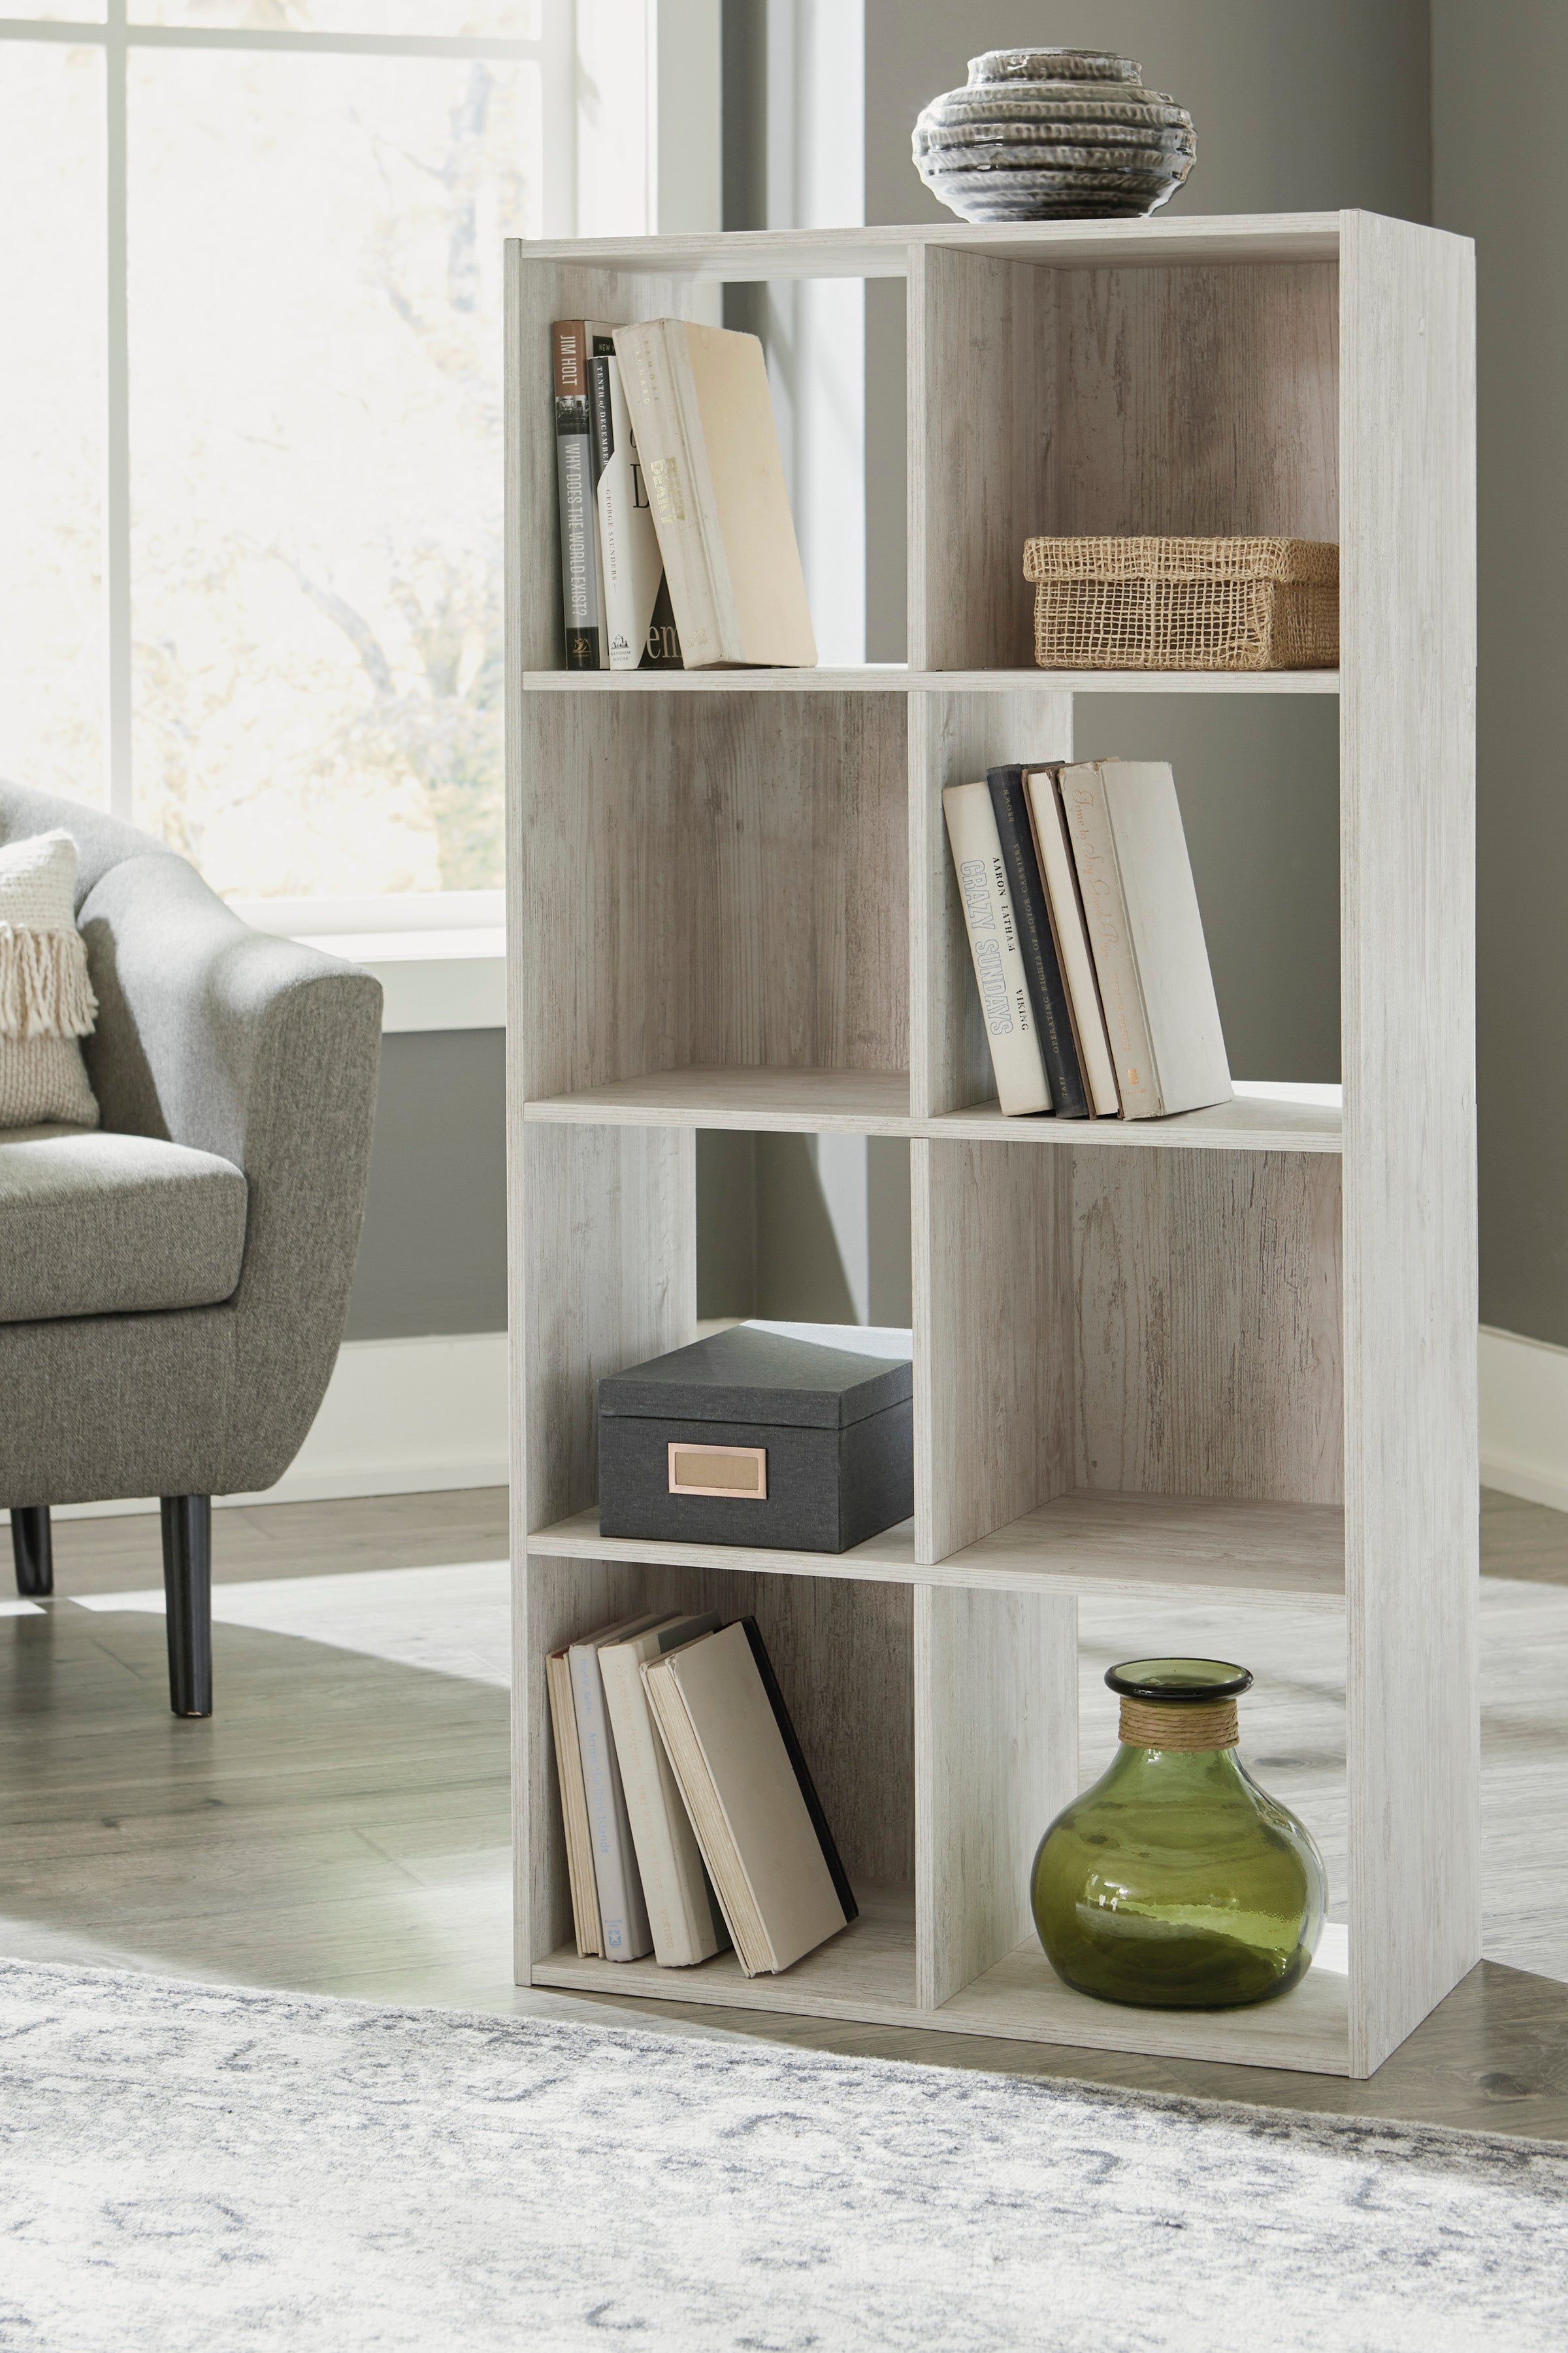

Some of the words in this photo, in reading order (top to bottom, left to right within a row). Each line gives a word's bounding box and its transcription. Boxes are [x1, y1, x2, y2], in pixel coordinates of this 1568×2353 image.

[560, 335, 576, 355] JIM
[561, 358, 578, 386] HOLT
[564, 443, 581, 470] WHY
[600, 412, 610, 466] DECEMBER
[566, 474, 582, 504] DOES
[568, 507, 583, 529] THE
[605, 489, 613, 527] GEORGE
[568, 532, 585, 574] WORLD
[608, 531, 617, 581] SAUNDERS
[570, 576, 587, 616] EXIST?
[1003, 789, 1015, 823] BROWN
[1072, 789, 1094, 827] Time
[1080, 830, 1089, 840] to
[1013, 843, 1028, 893] CARRIERS
[960, 859, 996, 930] CRAZY
[1024, 899, 1036, 934] MOTOR
[992, 857, 1006, 897] AARON
[1001, 905, 1016, 951] LATHAM
[1015, 989, 1029, 1030] VIKING
[1032, 938, 1039, 951] OF
[975, 939, 1013, 1036] SUNDAYS
[1035, 955, 1047, 992] RIGHTS
[1043, 997, 1059, 1053] OPERATING
[588, 1732, 597, 1764] Across
[595, 1789, 603, 1812] Dark
[597, 1815, 609, 1854] Islands
